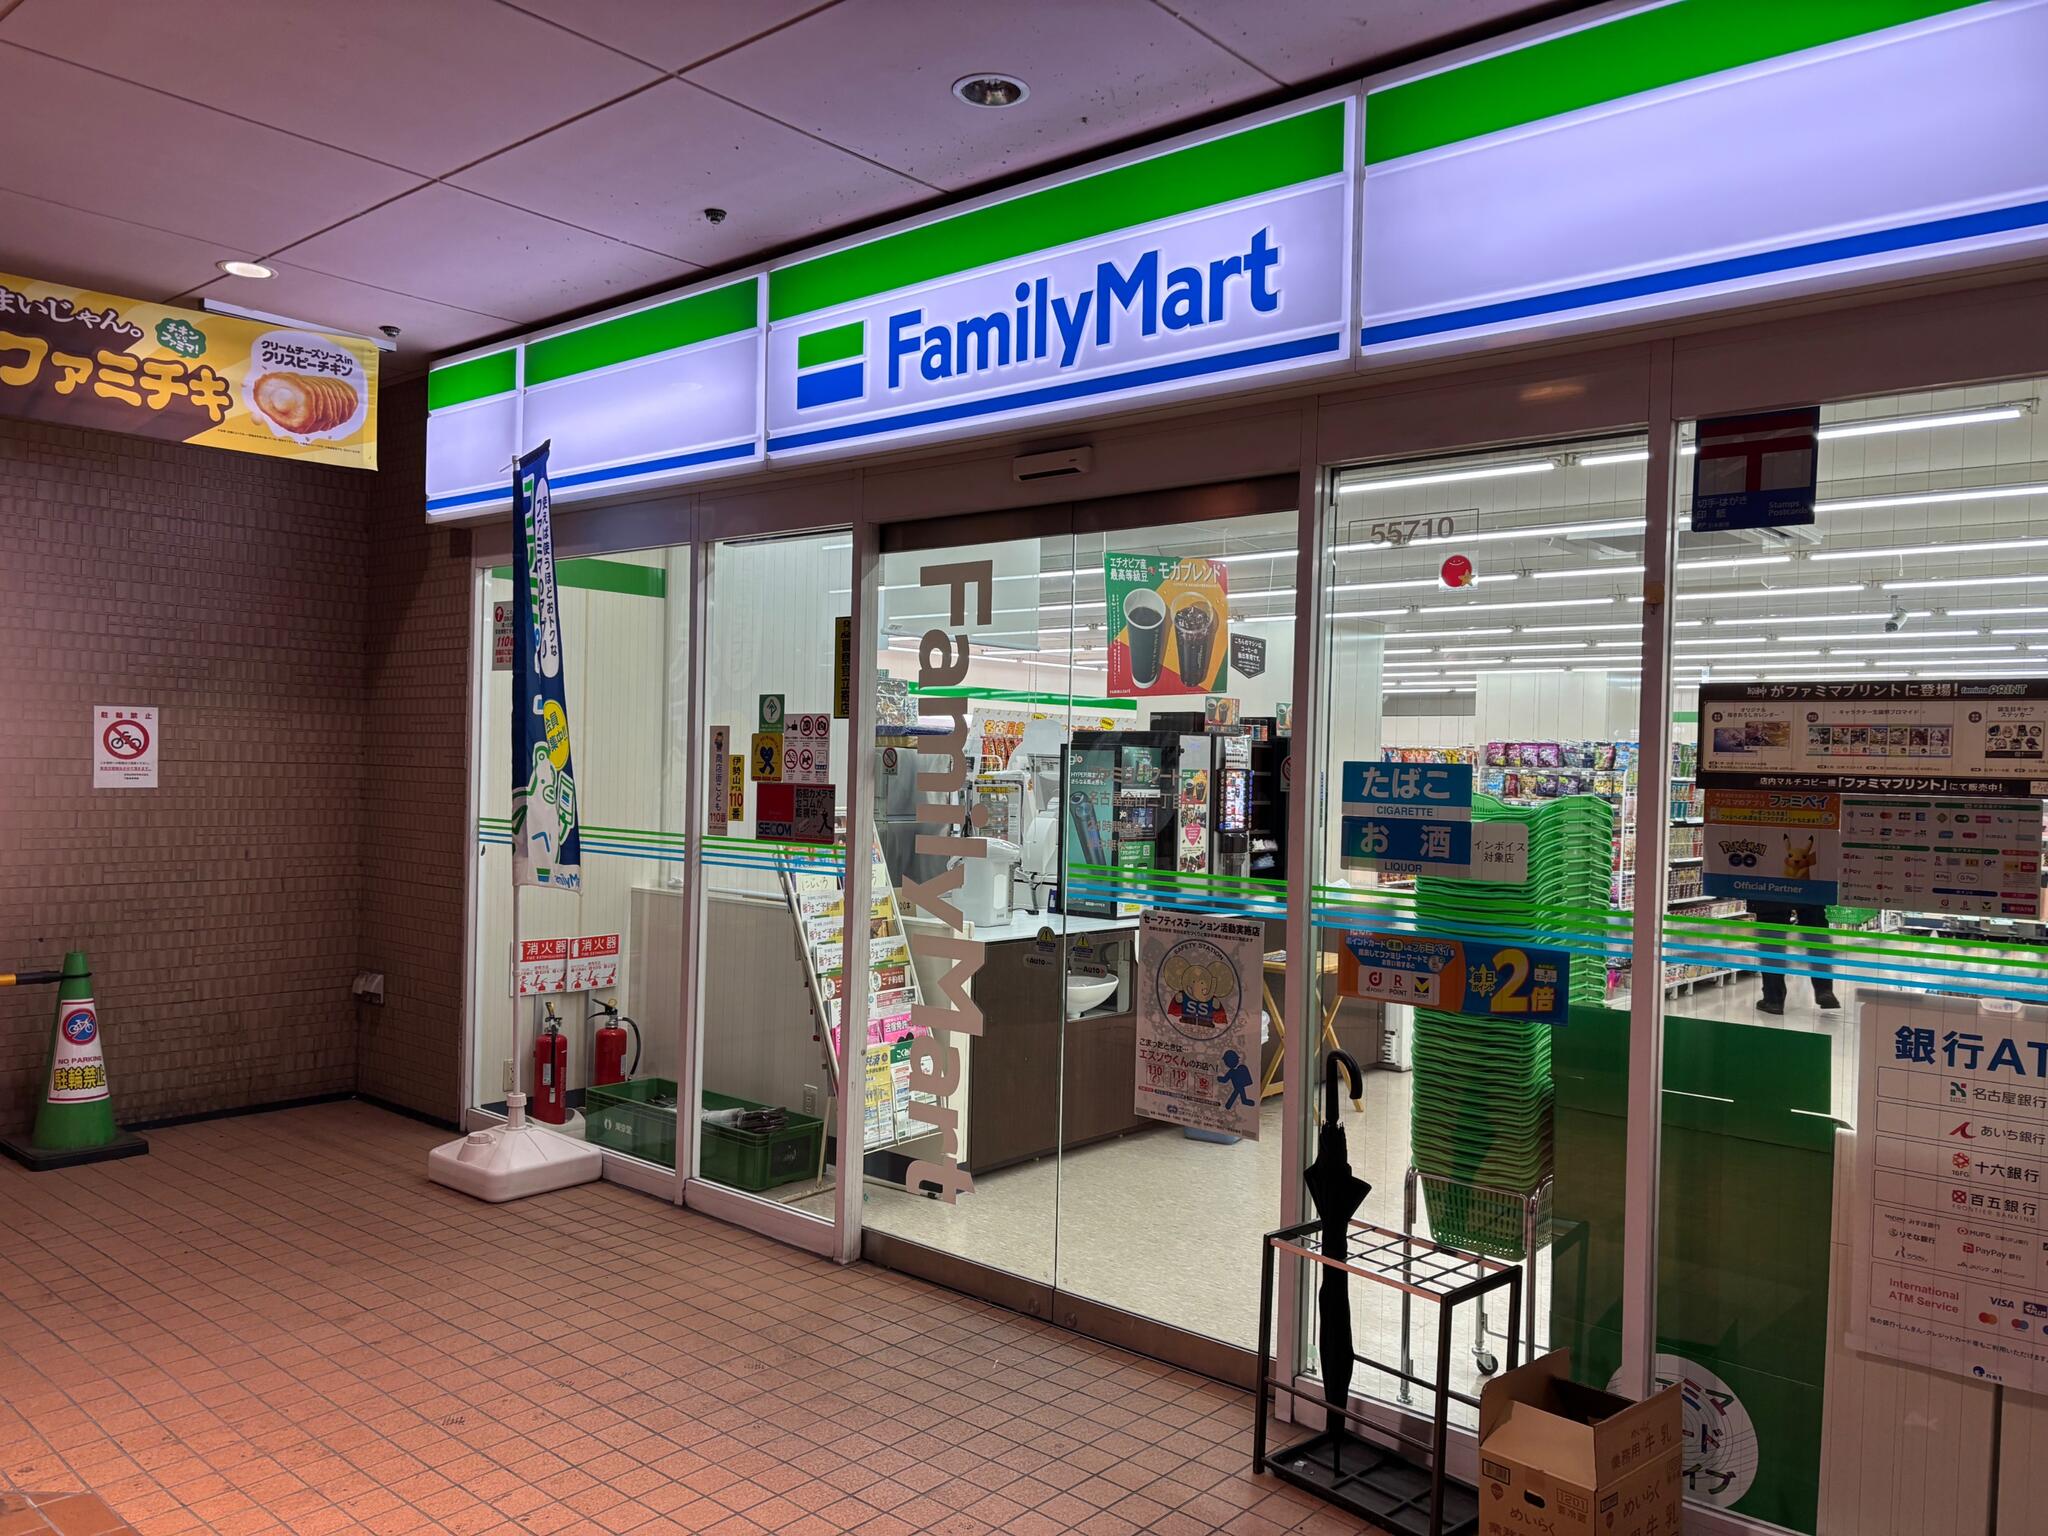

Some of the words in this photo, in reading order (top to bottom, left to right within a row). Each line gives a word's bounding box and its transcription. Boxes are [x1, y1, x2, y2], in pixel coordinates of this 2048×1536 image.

[888, 226, 1279, 389] FamilyMart
[261, 340, 353, 366] クリームチーズソースin
[262, 351, 353, 377] クリスピーチキン
[0, 331, 231, 423] ファミチキ
[1371, 517, 1455, 545] 55710
[1110, 558, 1148, 570] エチオピア産
[1110, 569, 1149, 583] 最高等級豆
[1158, 561, 1222, 583] モカブレンド
[101, 711, 152, 720] 駐輪禁止
[732, 757, 741, 784] 伊勢山
[1361, 767, 1450, 799] たばこ
[729, 793, 743, 807] 110
[1769, 795, 1829, 809] ファミペイ
[732, 808, 740, 819] 番
[1377, 806, 1433, 817] CIGARETTE
[758, 823, 792, 836] SECOM
[1360, 822, 1452, 859] お酒
[1474, 841, 1526, 851] インボイス
[1484, 853, 1515, 864] 対象店
[1729, 854, 1757, 868] GO
[1384, 862, 1423, 873] LIQUOR
[902, 560, 993, 1205] FamilyMart
[1733, 880, 1767, 891] Official
[1768, 883, 1803, 893] Partner
[1143, 914, 1260, 937] セーフティステーション活動実施店
[527, 940, 566, 956] 消火器
[581, 936, 617, 952] 消火器
[1174, 943, 1197, 955] SAFETY
[1029, 957, 1045, 966] Auto
[1083, 965, 1100, 974] Auto
[1473, 973, 1494, 983] 毎日
[1491, 948, 1529, 1013] 2
[1531, 986, 1555, 1012] 倍
[1389, 988, 1408, 997] POINT
[1472, 984, 1495, 992] ポイント
[1187, 1001, 1209, 1016] SS
[53, 1064, 105, 1091] 駐輪禁止
[1972, 1087, 2047, 1109] 名古屋銀行
[1981, 1126, 2046, 1145] あいち銀行
[1975, 1161, 2040, 1183] 十六銀行
[1971, 1194, 2037, 1216] 百五銀行
[1976, 1246, 2007, 1260] PayPay
[1889, 1277, 1960, 1301] International
[1889, 1290, 1914, 1305] ATM
[1916, 1296, 1960, 1314] Service
[1989, 1296, 2015, 1309] VISA
[1510, 1506, 1556, 1536] めいらく
